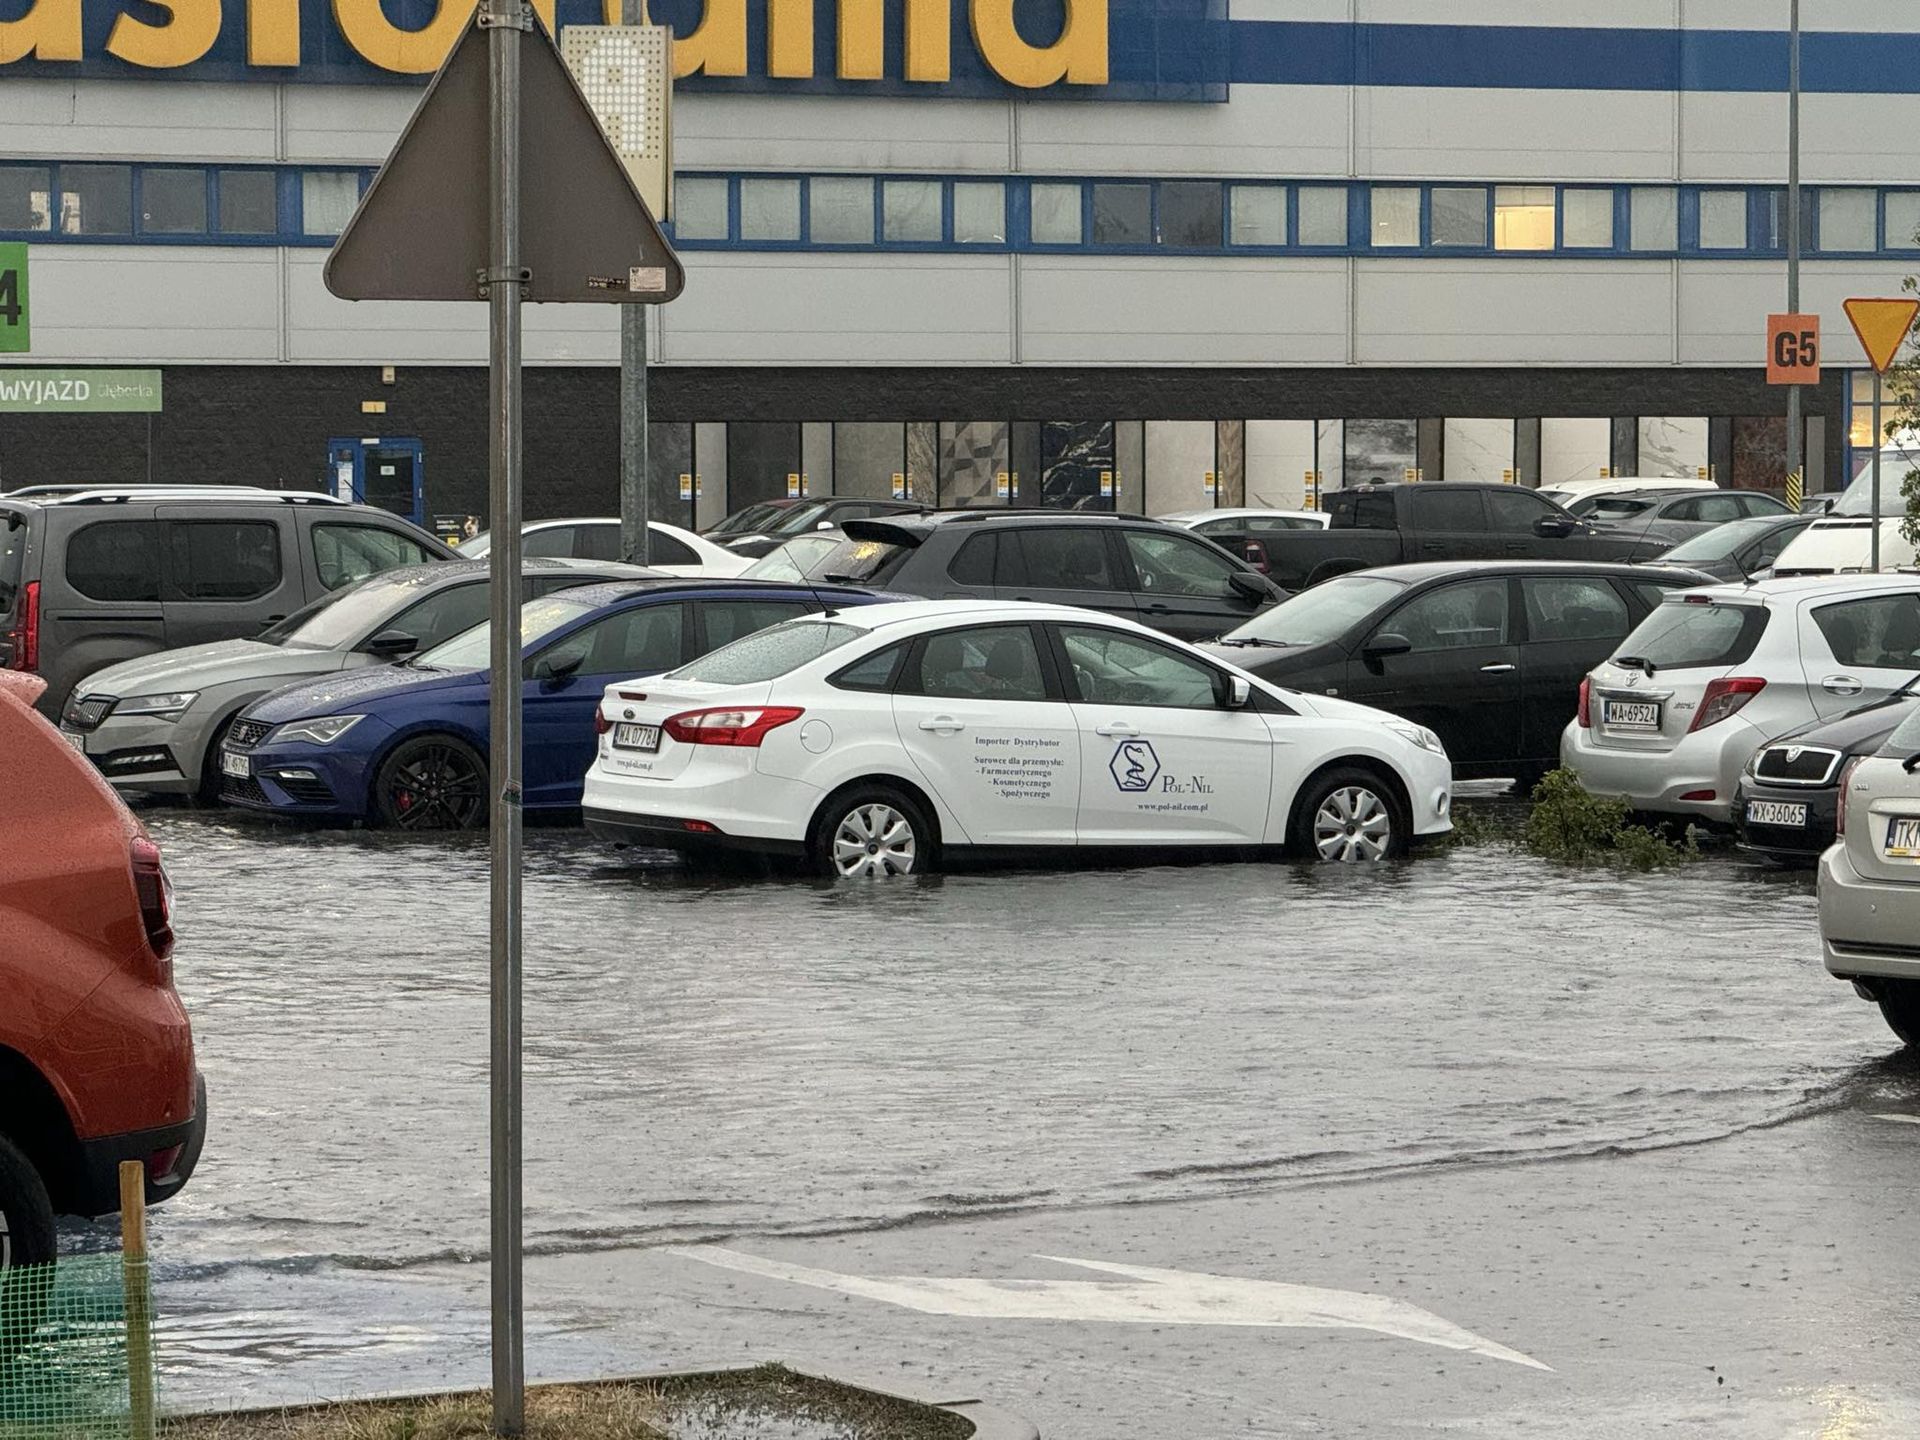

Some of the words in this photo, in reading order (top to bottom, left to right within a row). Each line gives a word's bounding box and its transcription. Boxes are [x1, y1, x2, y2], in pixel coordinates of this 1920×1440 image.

[1775, 331, 1816, 367] G5
[0, 380, 90, 404] WYJAZD
[1627, 705, 1656, 722] 6952A
[975, 736, 1010, 747] Importer
[1014, 738, 1061, 748] Dystrybutor
[975, 756, 1006, 765] Surowce
[1008, 757, 1020, 765] dla
[1770, 804, 1805, 824] 36065
